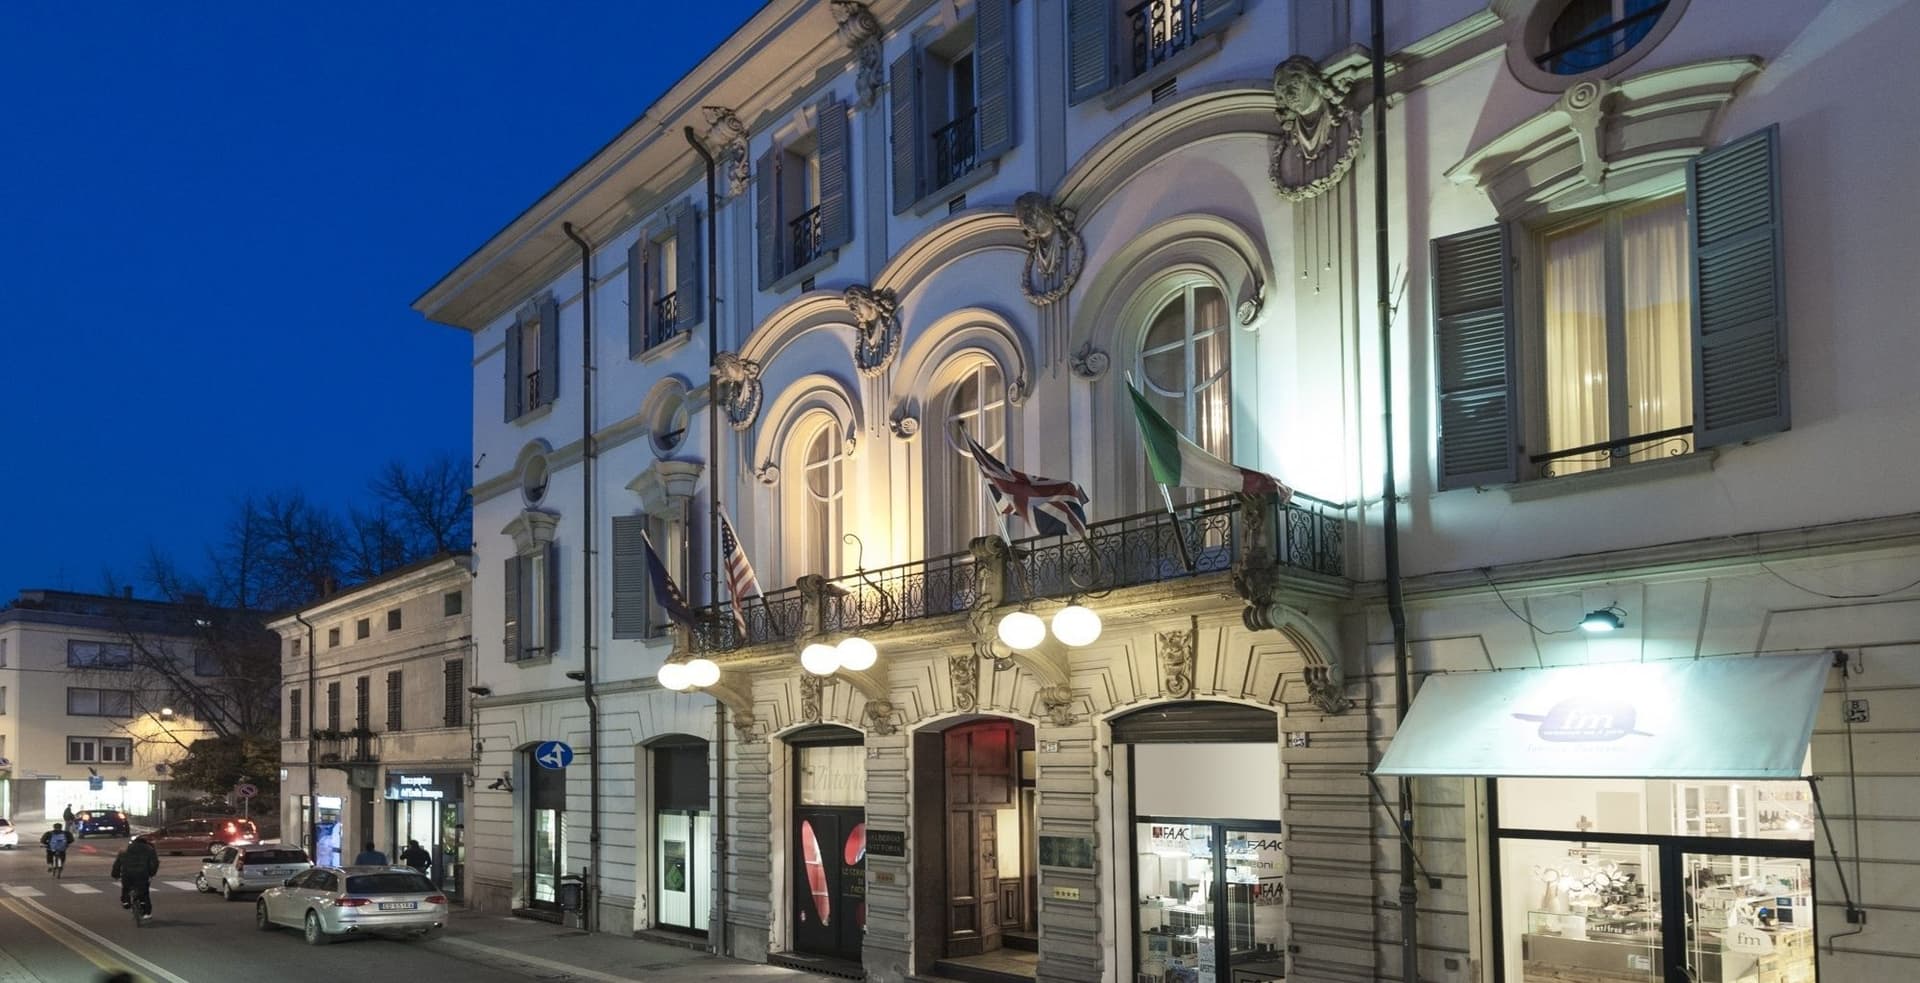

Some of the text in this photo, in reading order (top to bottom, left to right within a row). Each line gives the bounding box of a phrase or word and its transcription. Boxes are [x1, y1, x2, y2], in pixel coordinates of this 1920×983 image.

[1562, 707, 1616, 731] fm
[1163, 827, 1190, 840] FAAC
[1262, 883, 1284, 897] FAA
[1738, 932, 1760, 946] fm
